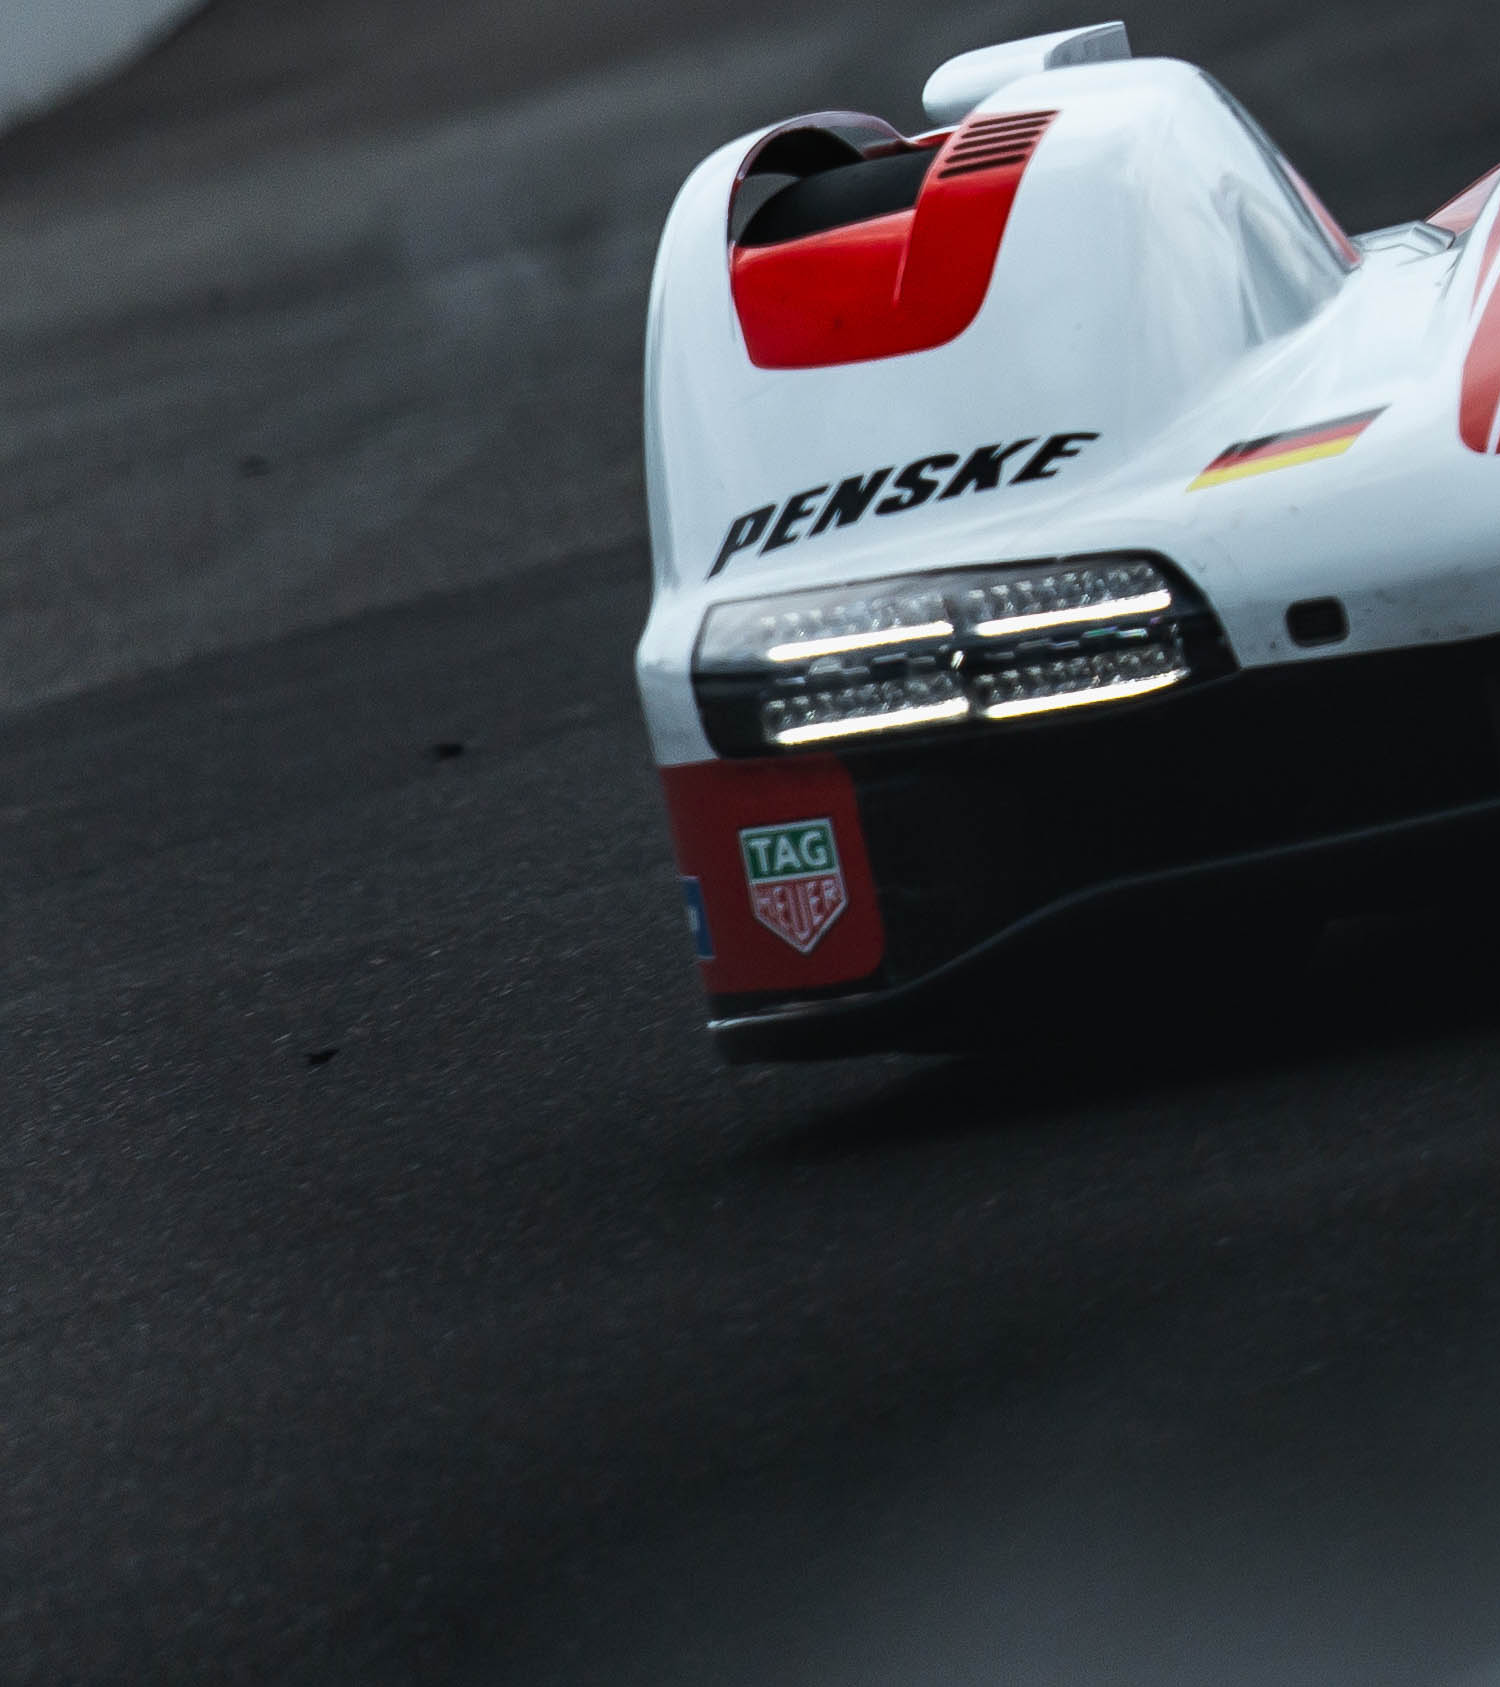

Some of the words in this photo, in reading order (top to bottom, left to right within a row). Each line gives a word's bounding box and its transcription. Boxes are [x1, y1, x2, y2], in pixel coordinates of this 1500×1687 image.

[705, 431, 1101, 581] PENSKE
[749, 830, 828, 876] TAG
[752, 878, 840, 942] HEUER
